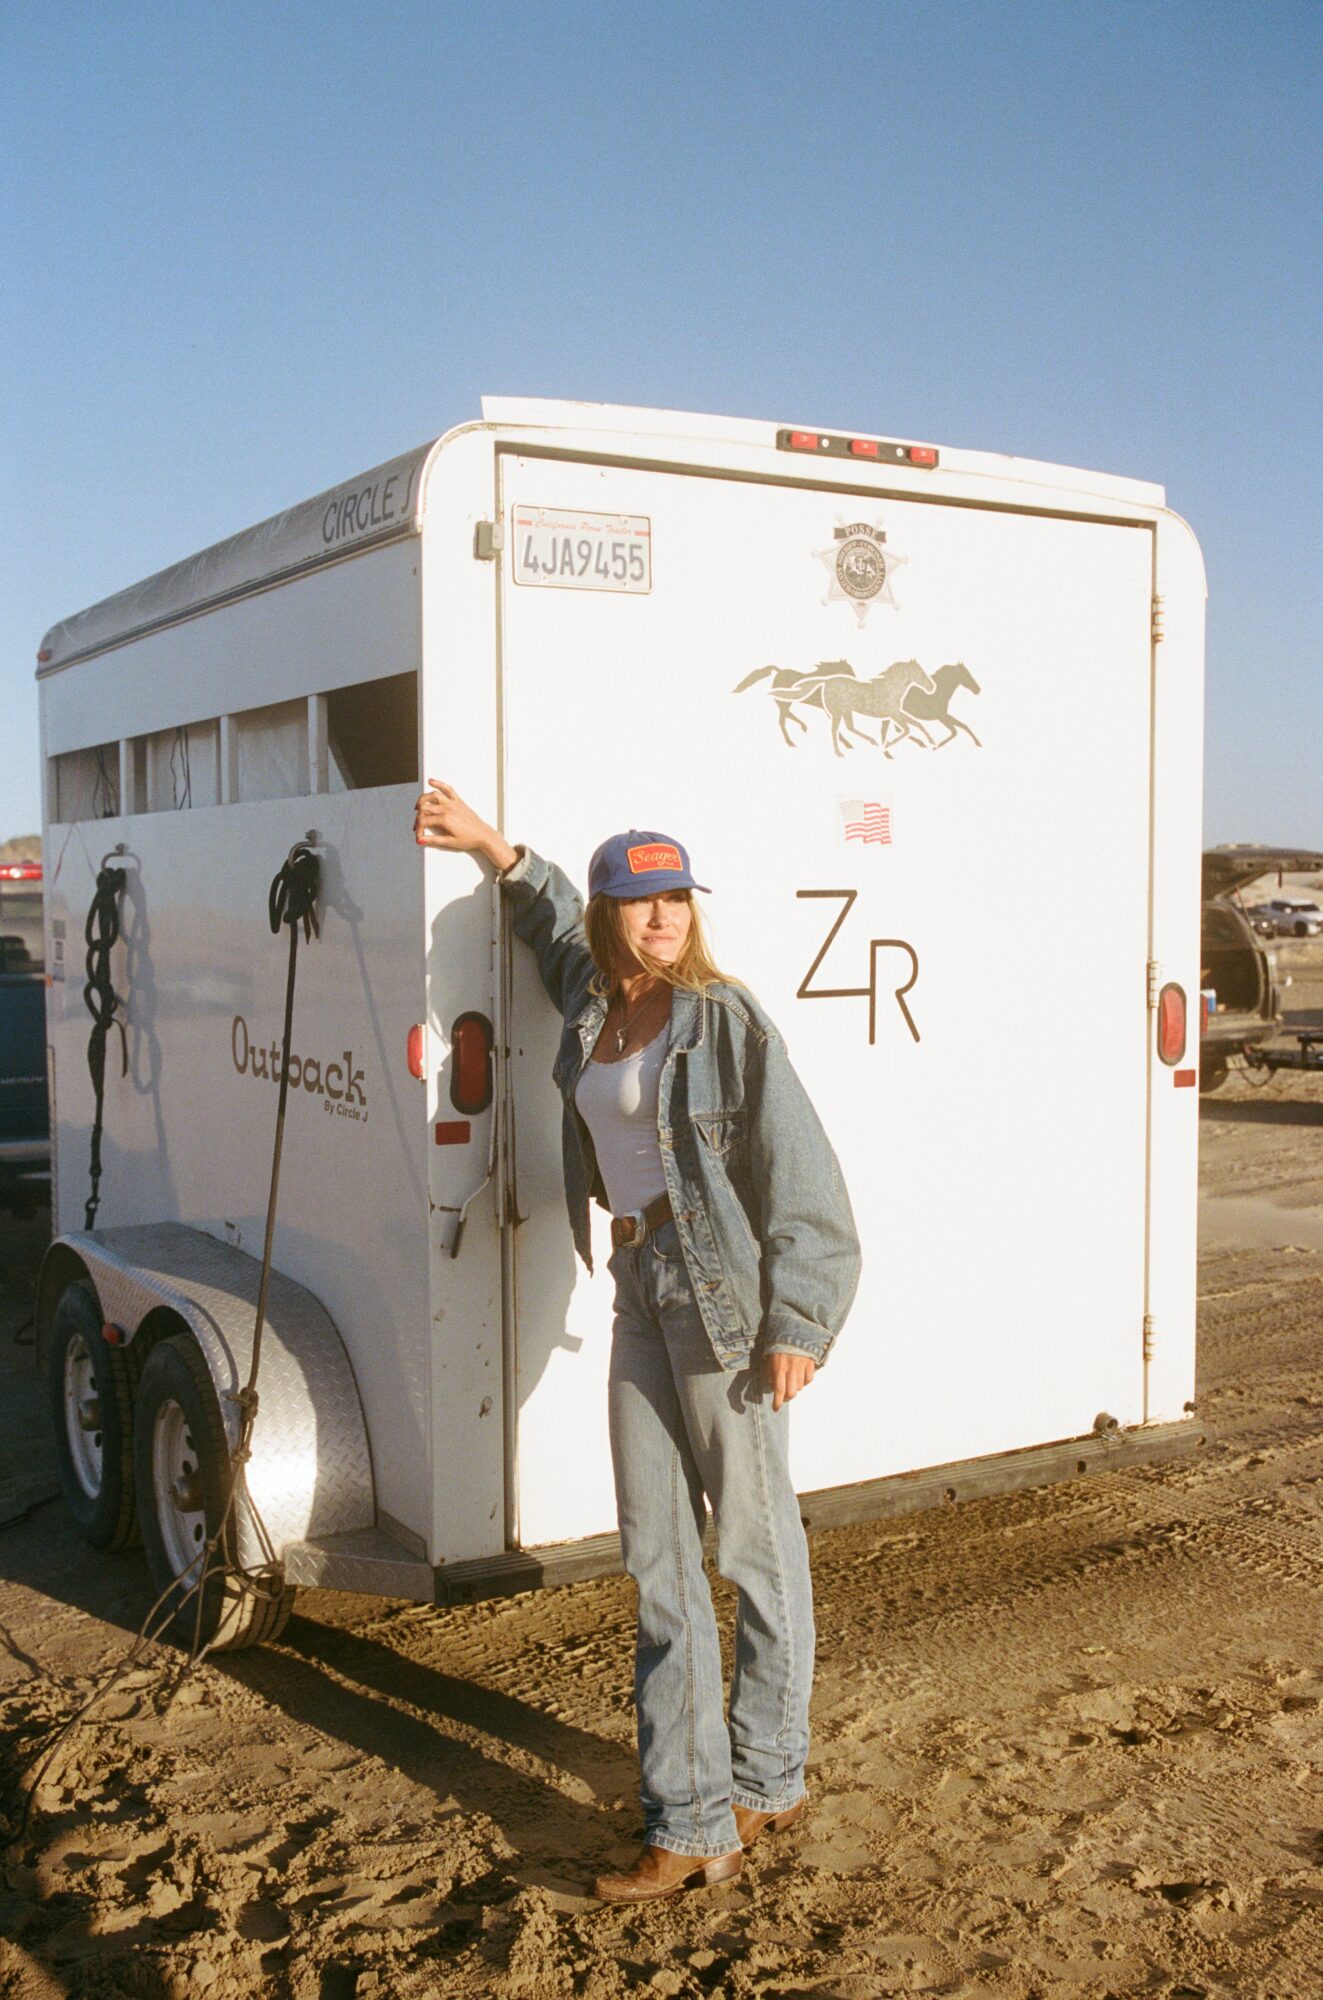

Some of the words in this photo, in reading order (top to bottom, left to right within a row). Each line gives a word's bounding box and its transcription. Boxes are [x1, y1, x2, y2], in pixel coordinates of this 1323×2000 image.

[322, 475, 399, 544] CIRCLE
[401, 468, 416, 514] J
[844, 524, 880, 540] POSSE
[523, 534, 645, 582] 4JA9455
[633, 850, 680, 866] Seager
[232, 1015, 367, 1106] Outback
[324, 1100, 335, 1116] By
[336, 1103, 361, 1121] Circle
[362, 1111, 369, 1123] J
